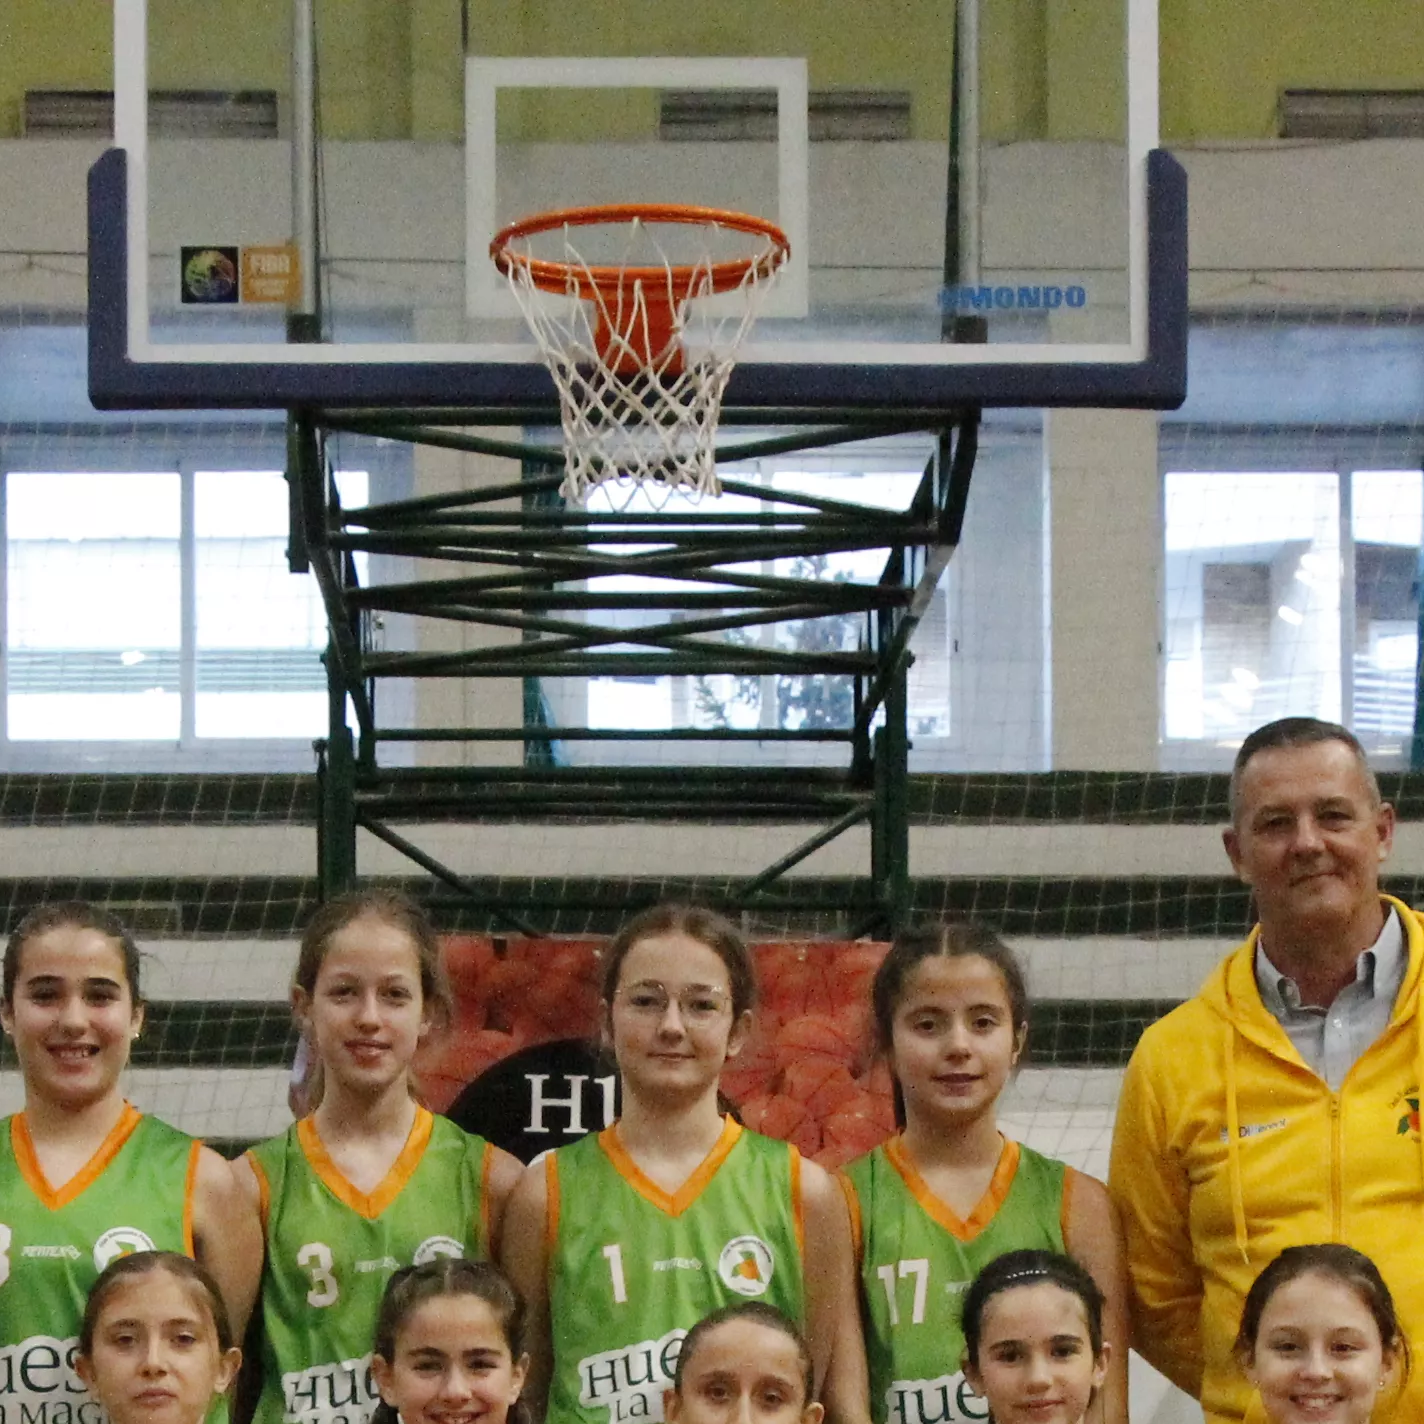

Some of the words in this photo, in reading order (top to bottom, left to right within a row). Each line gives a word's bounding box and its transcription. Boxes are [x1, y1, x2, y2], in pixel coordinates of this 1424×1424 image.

[961, 284, 1086, 309] MONDO
[297, 1242, 339, 1308] 3
[602, 1243, 628, 1304] 1
[877, 1258, 929, 1327] 17
